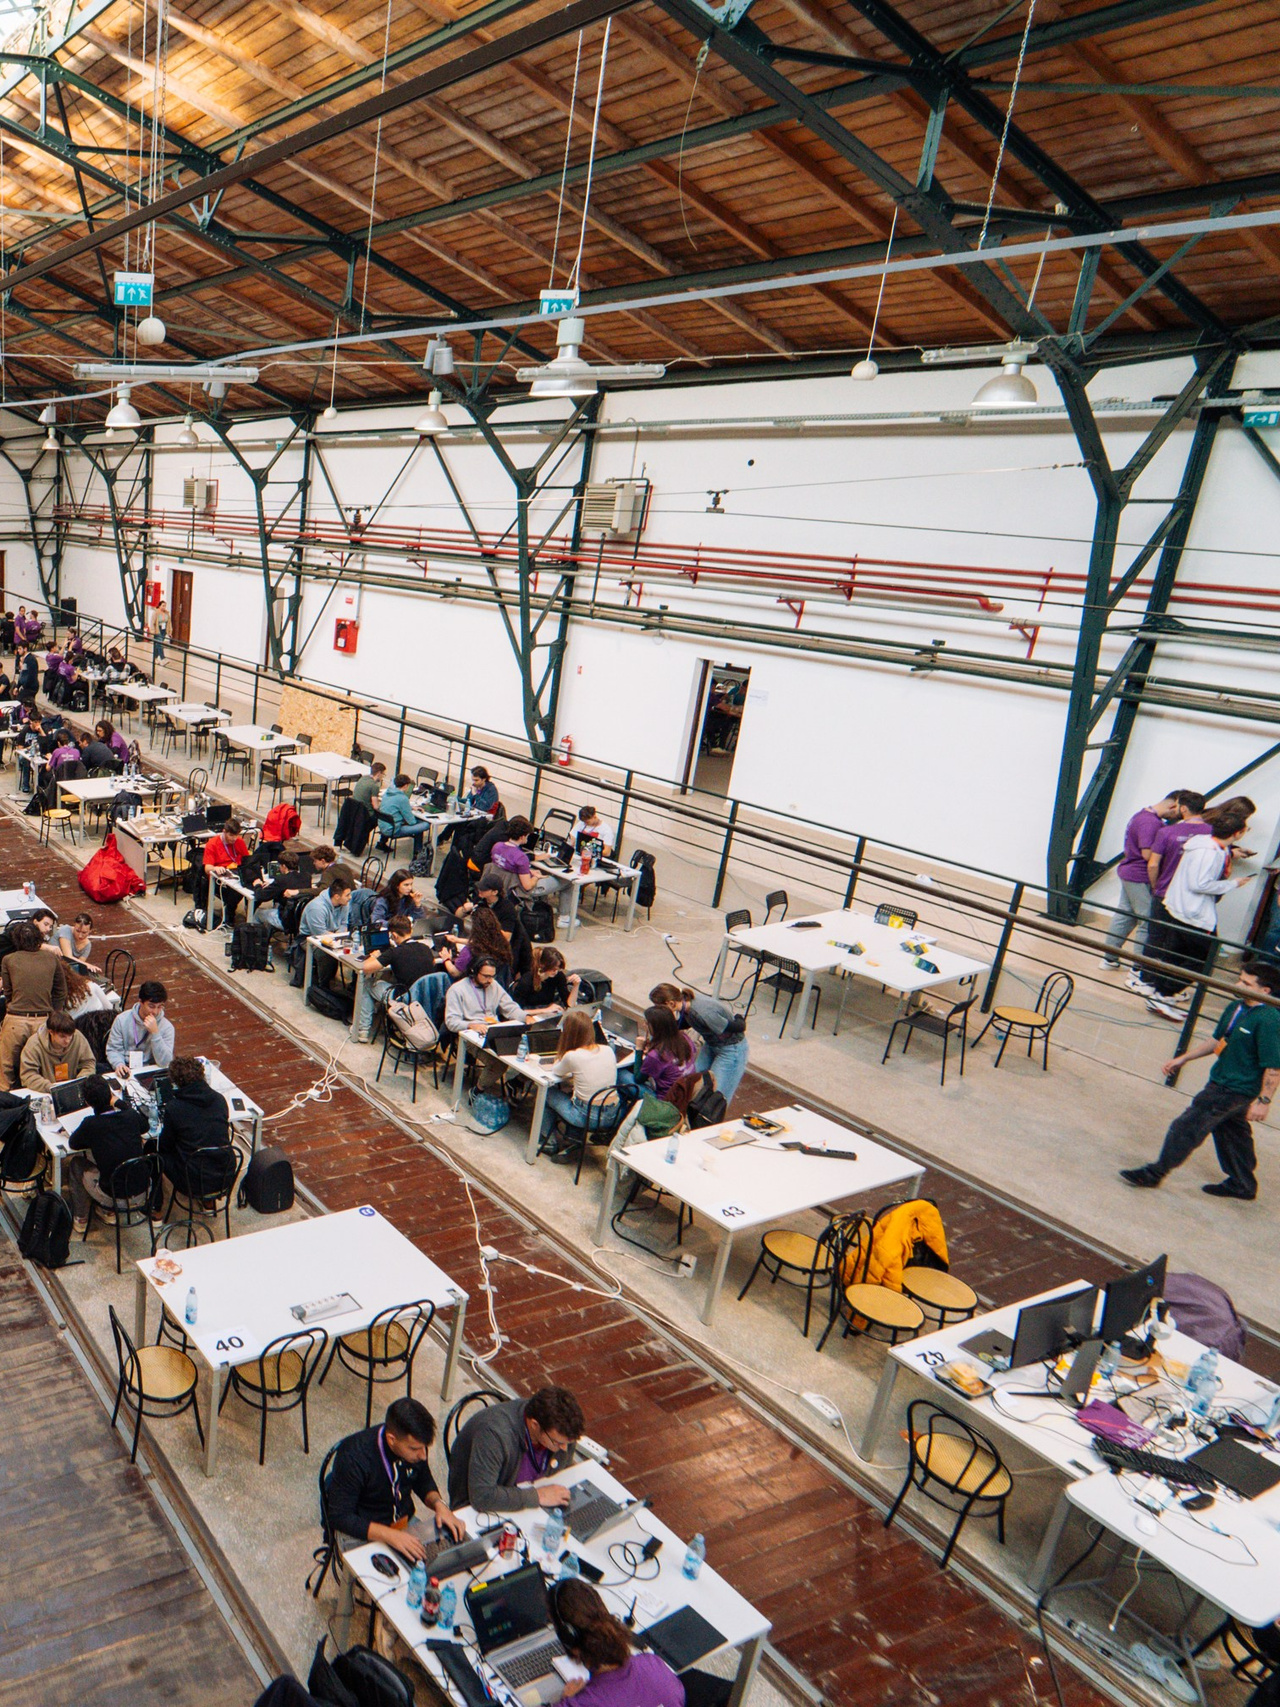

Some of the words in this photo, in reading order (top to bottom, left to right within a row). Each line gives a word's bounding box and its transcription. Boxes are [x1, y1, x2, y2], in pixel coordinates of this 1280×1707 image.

[721, 1205, 746, 1218] 43
[215, 1335, 245, 1351] 40
[915, 1350, 946, 1366] 42
